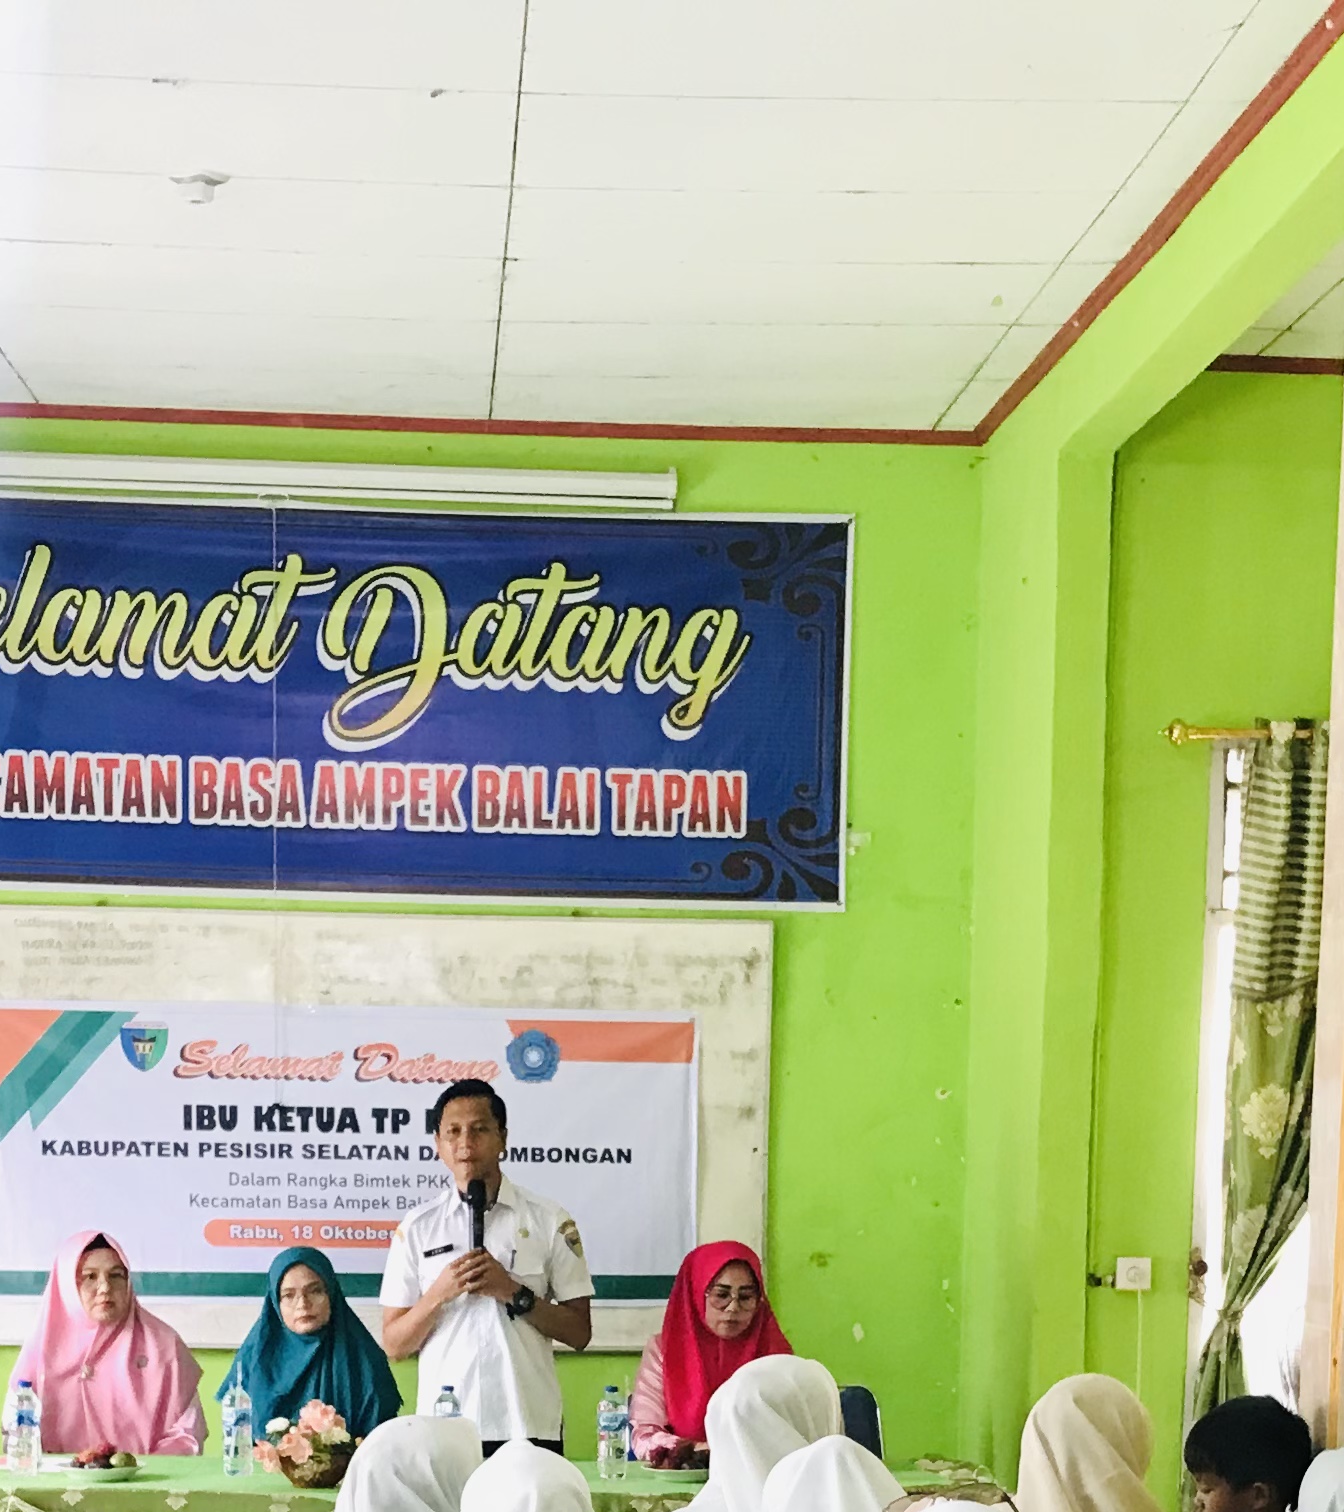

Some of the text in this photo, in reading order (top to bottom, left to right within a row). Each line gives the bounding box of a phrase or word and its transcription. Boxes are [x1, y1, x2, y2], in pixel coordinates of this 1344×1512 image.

[316, 561, 752, 752] Datang
[189, 756, 307, 828] BASA
[309, 760, 467, 832] AMPEK
[471, 765, 600, 835] BALAI
[607, 768, 747, 838] TAPAN
[173, 1039, 501, 1083] Selamat Datang
[183, 1104, 238, 1131] IBU
[254, 1105, 361, 1133] KETUA
[371, 1107, 410, 1135] TP
[41, 1140, 632, 1163] KABUPATEN PESISIR SELATAN DA OMBONGAN
[229, 1172, 450, 1190] Dalam Rangka Bimtek PKK
[189, 1194, 281, 1208] Kecamatan
[287, 1195, 328, 1209] Basa
[333, 1196, 390, 1212] Ampek
[230, 1225, 395, 1241] Rabu, 18 Oktober
